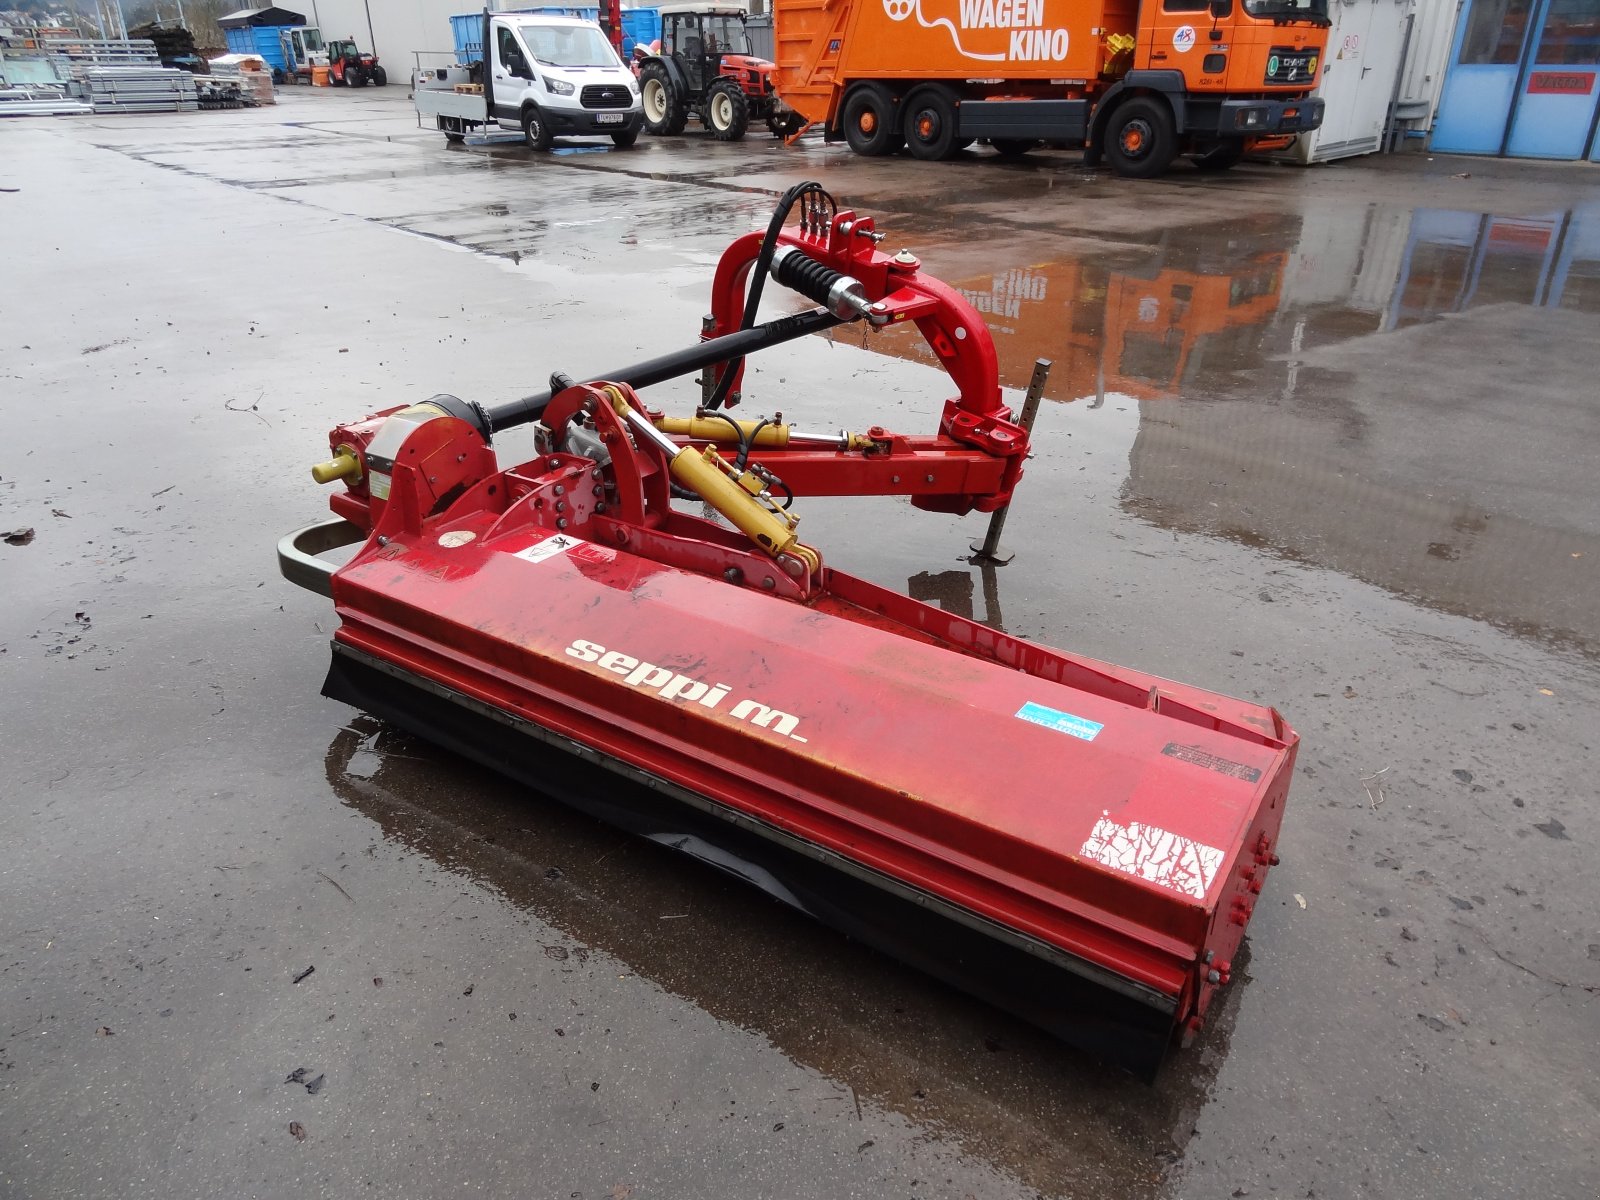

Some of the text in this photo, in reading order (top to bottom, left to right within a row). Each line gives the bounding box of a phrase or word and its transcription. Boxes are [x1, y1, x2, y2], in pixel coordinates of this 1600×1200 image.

[959, 0, 1044, 29] WAGEN
[1009, 28, 1070, 61] KINO
[1536, 77, 1586, 89] VALTRA
[565, 639, 733, 709] seppi
